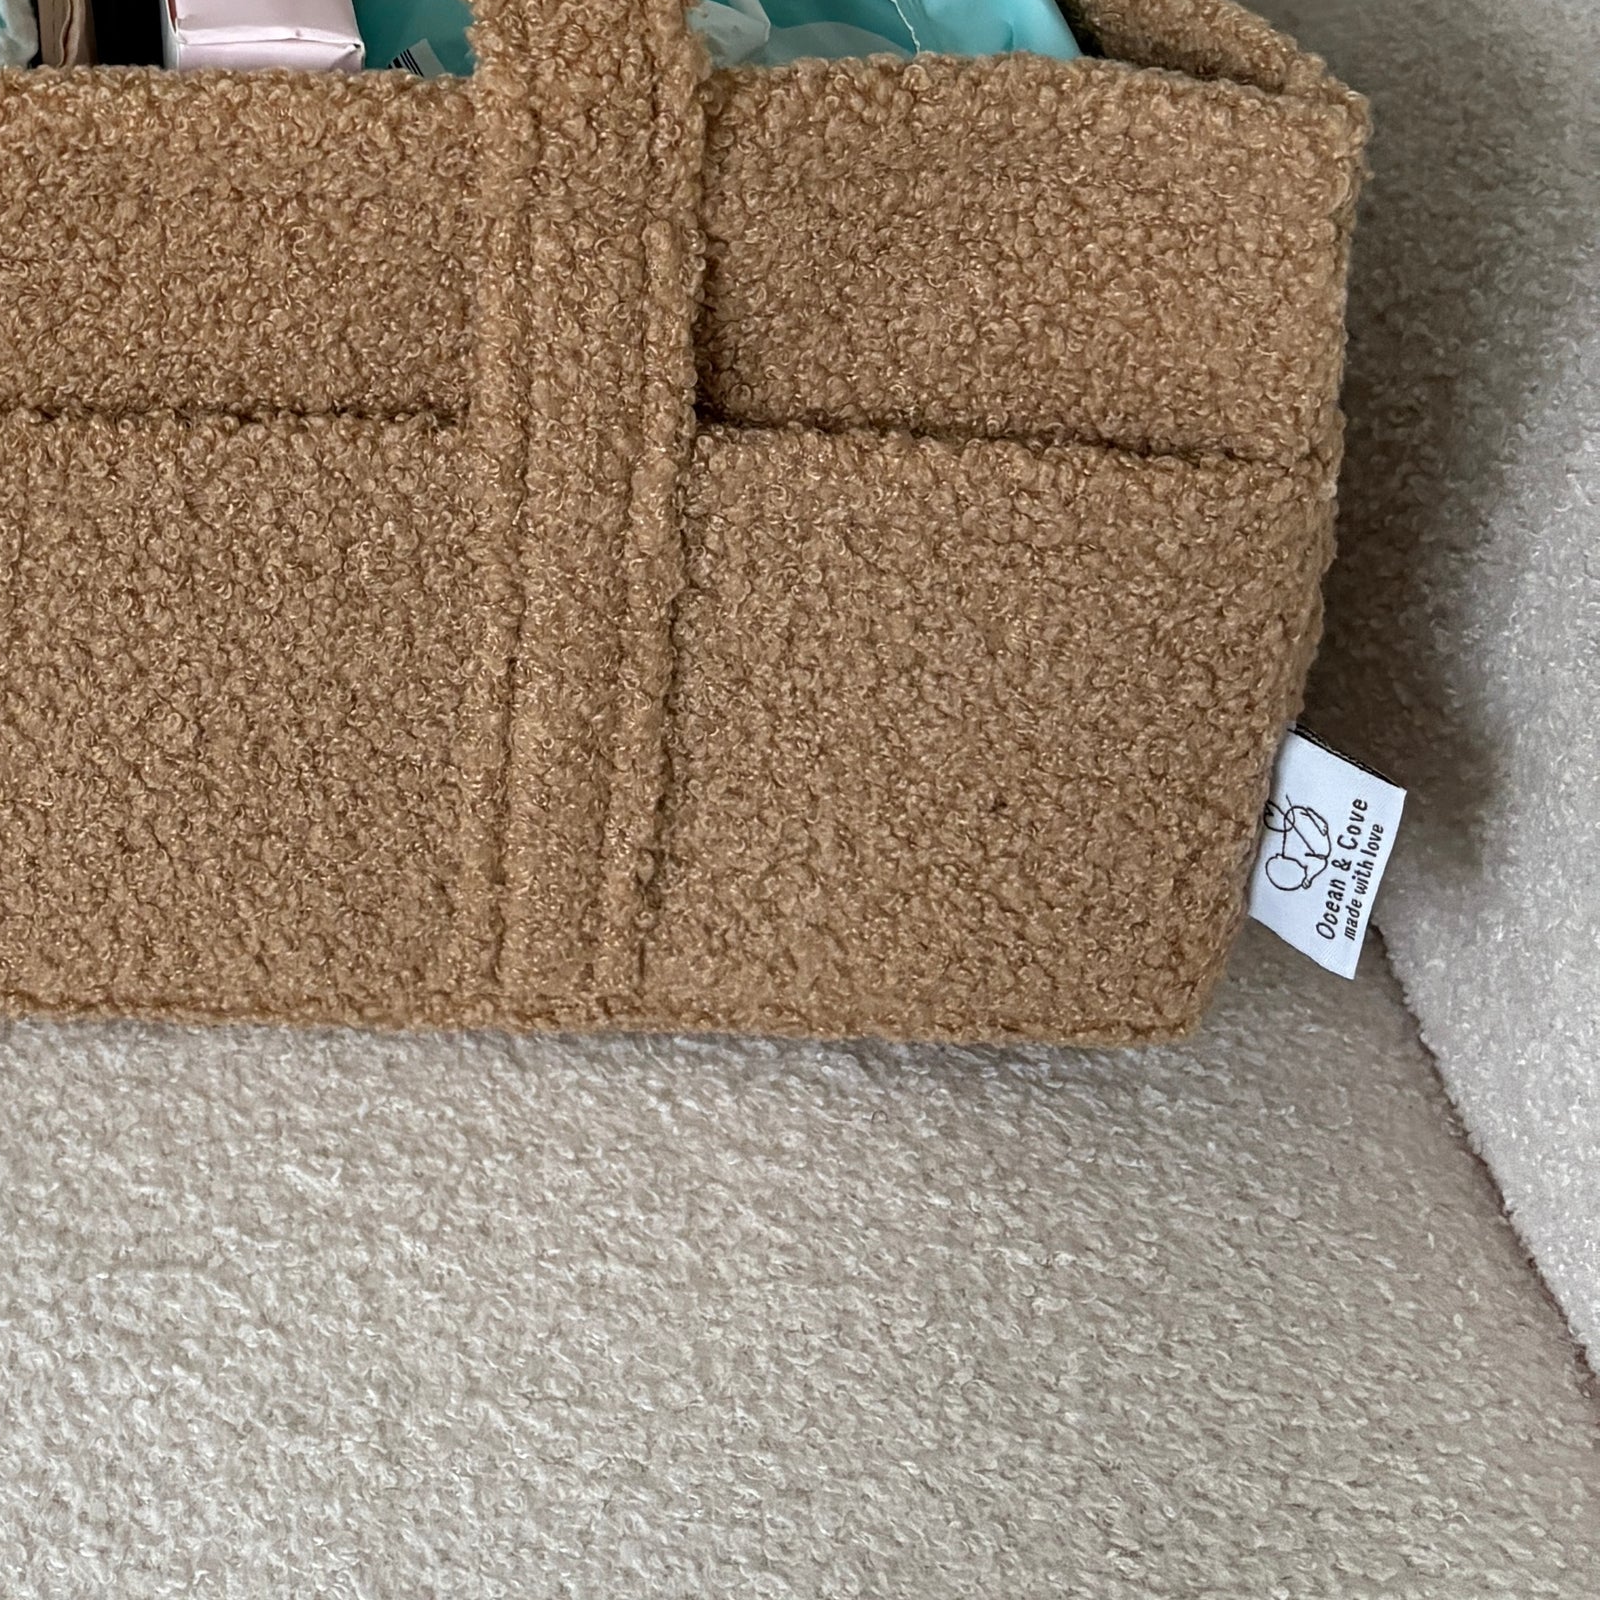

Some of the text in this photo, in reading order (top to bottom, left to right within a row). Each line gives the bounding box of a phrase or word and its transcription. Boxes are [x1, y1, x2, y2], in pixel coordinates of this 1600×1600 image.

[1316, 798, 1368, 940] Ocean & Cove
[1344, 823, 1384, 941] made with love
